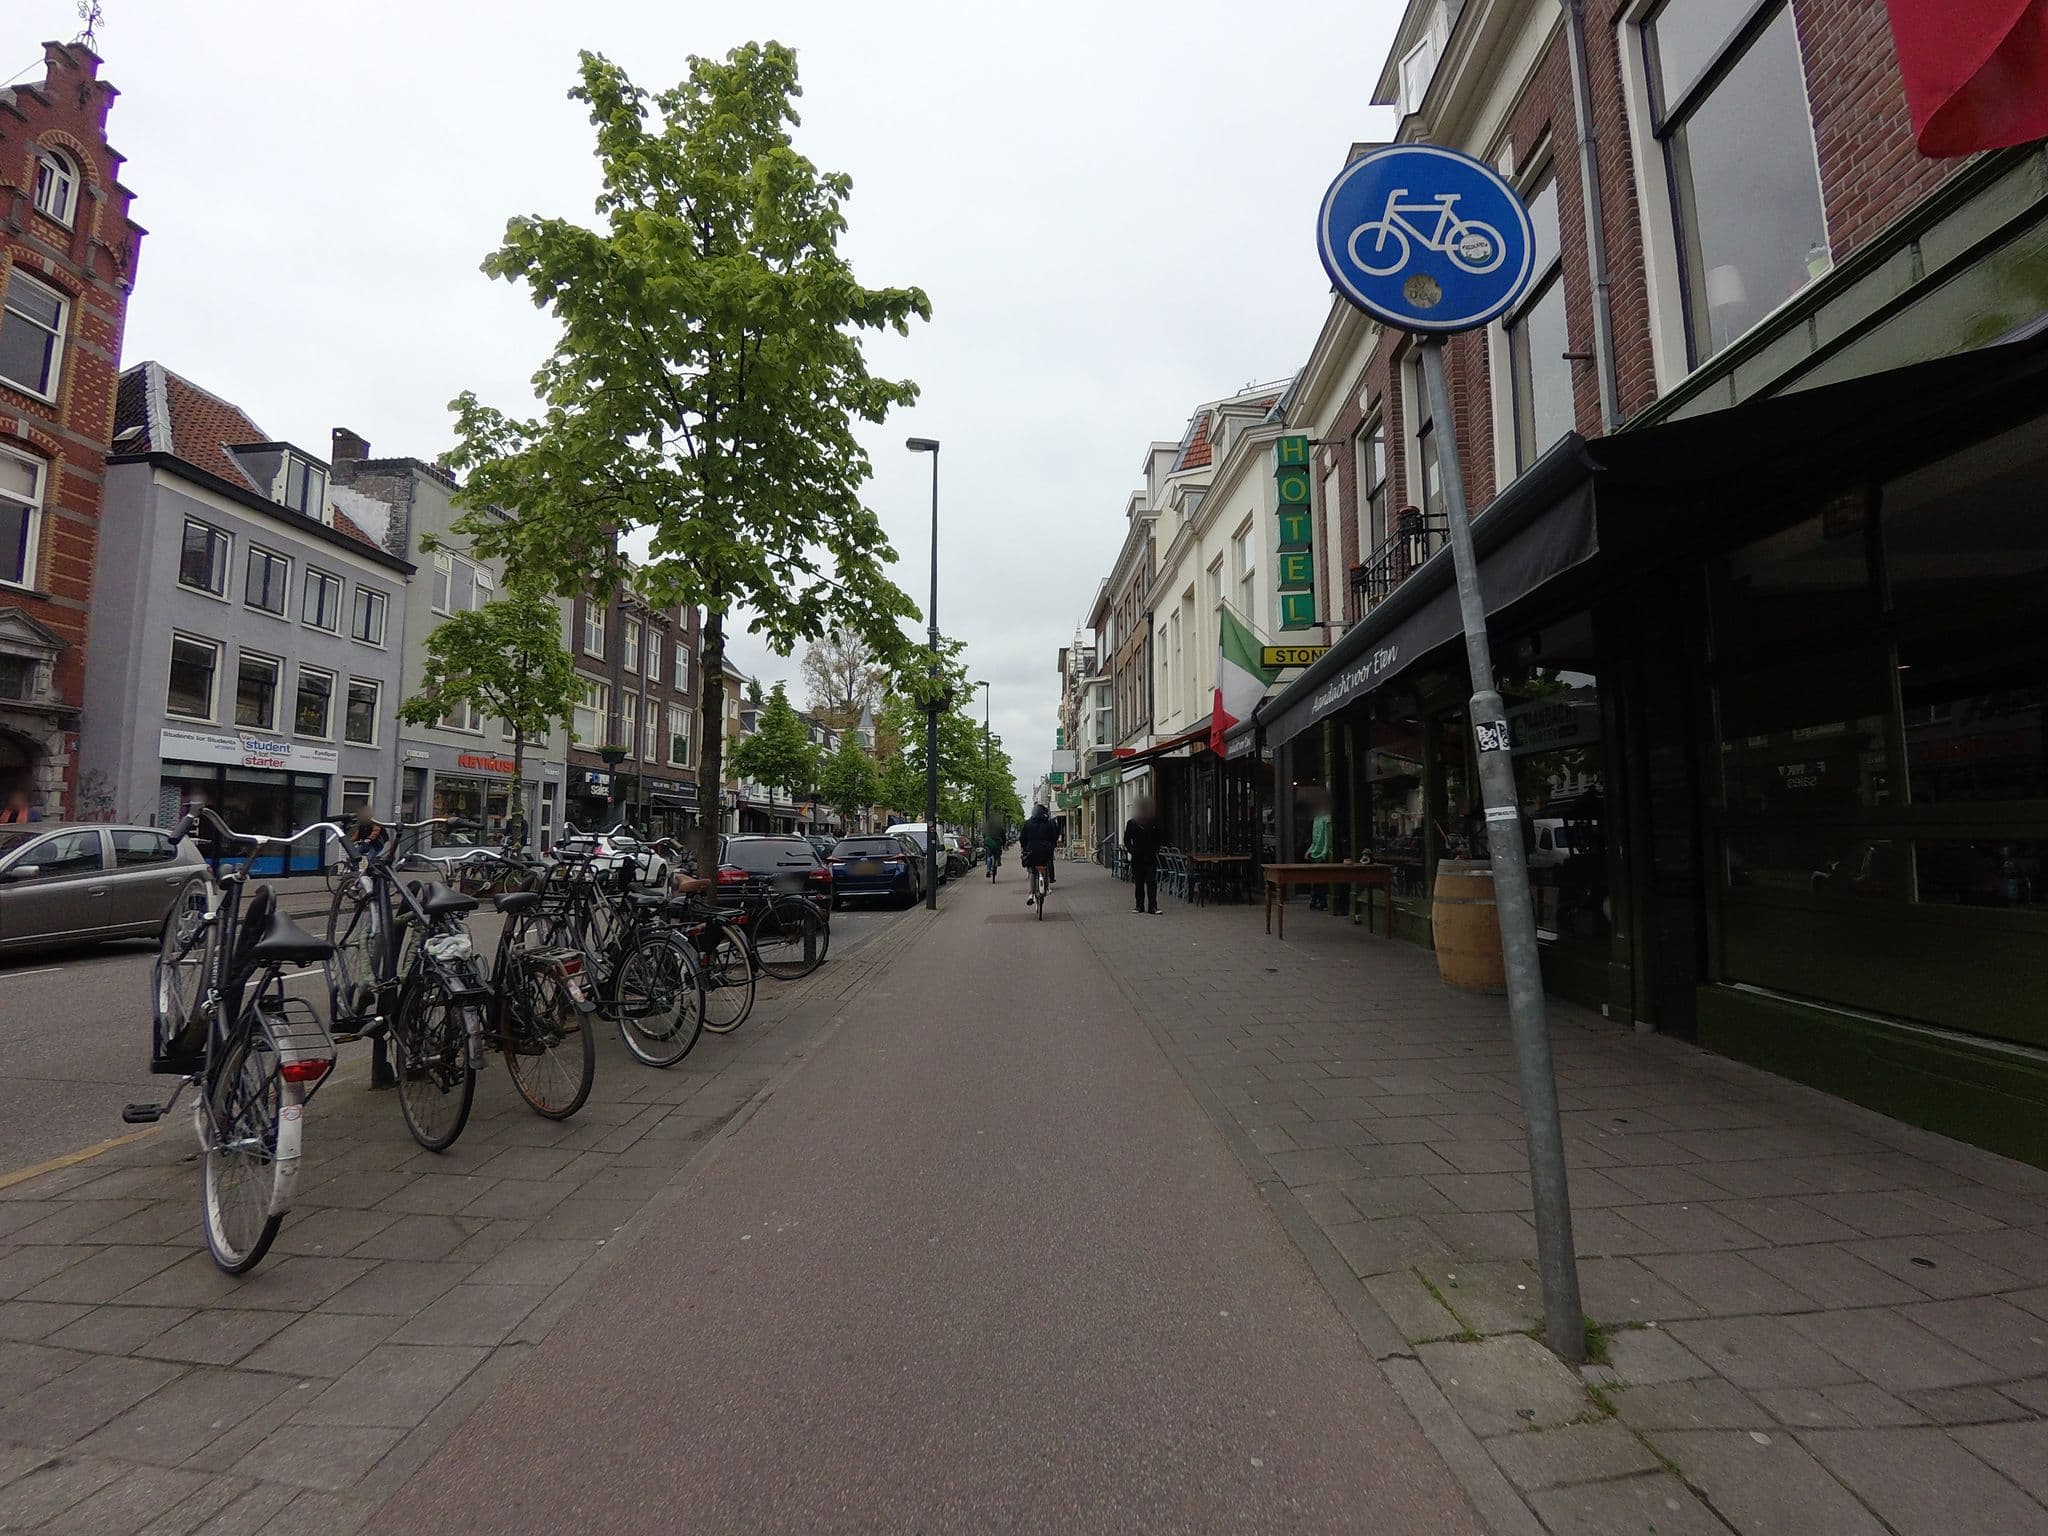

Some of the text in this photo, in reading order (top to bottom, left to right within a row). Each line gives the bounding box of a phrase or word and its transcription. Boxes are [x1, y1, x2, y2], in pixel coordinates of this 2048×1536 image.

[1281, 437, 1307, 621] HOTEL
[1275, 649, 1328, 663] STON
[1373, 645, 1399, 675] Eten
[162, 730, 195, 741] Students
[207, 736, 236, 745] Students
[246, 740, 291, 754] student
[245, 756, 285, 768] starter
[458, 753, 515, 773] KEYMUSI
